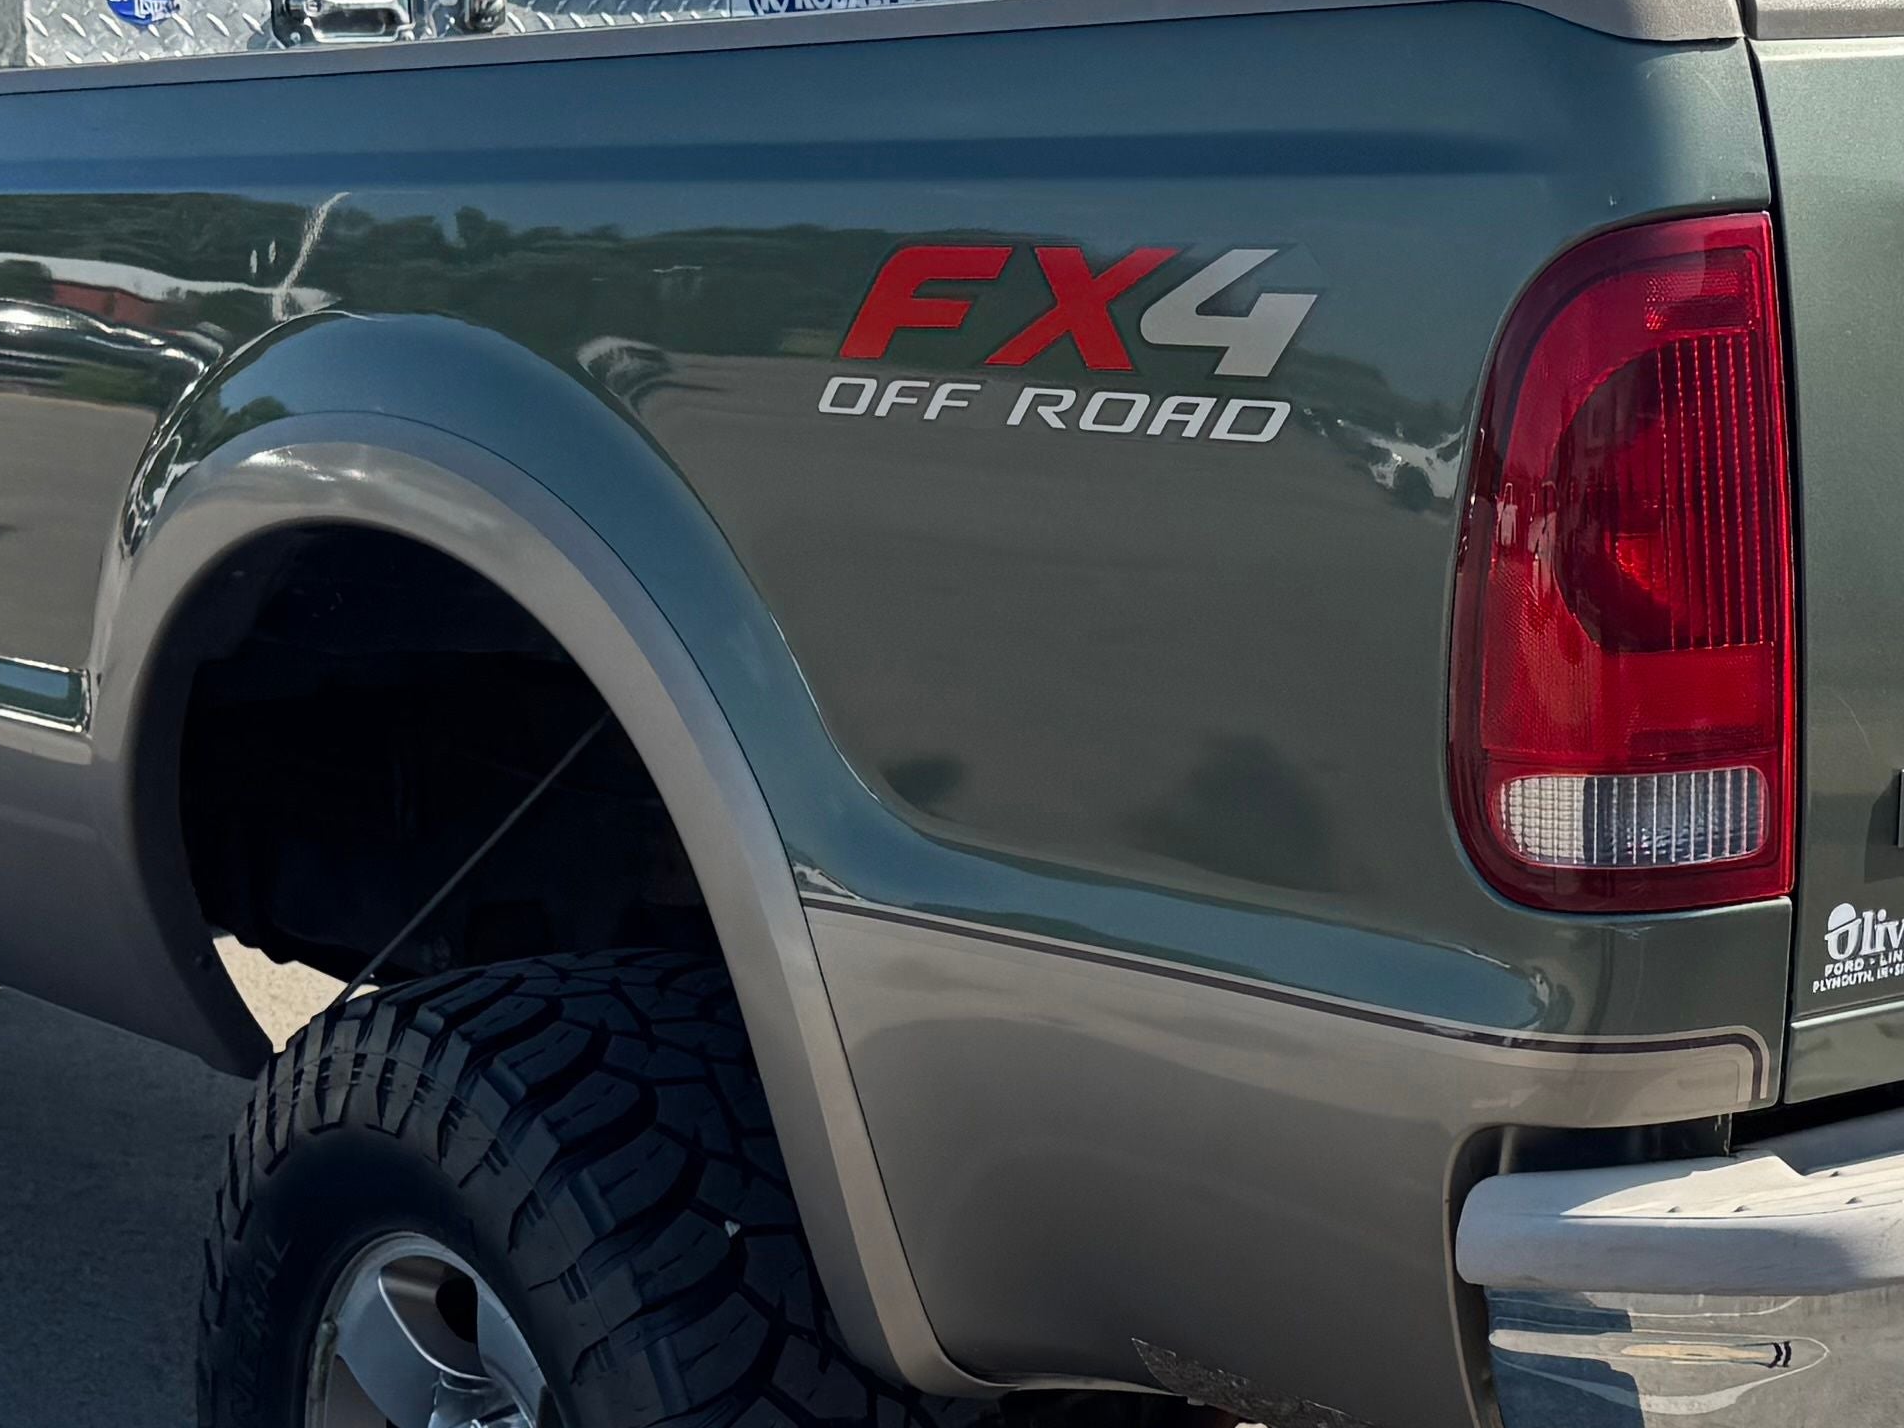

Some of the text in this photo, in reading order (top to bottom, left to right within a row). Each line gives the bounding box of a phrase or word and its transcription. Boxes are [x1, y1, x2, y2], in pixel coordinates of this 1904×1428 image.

[839, 245, 1318, 378] FX4
[818, 376, 1291, 443] OFF ROAD
[1825, 958, 1864, 977] FORD
